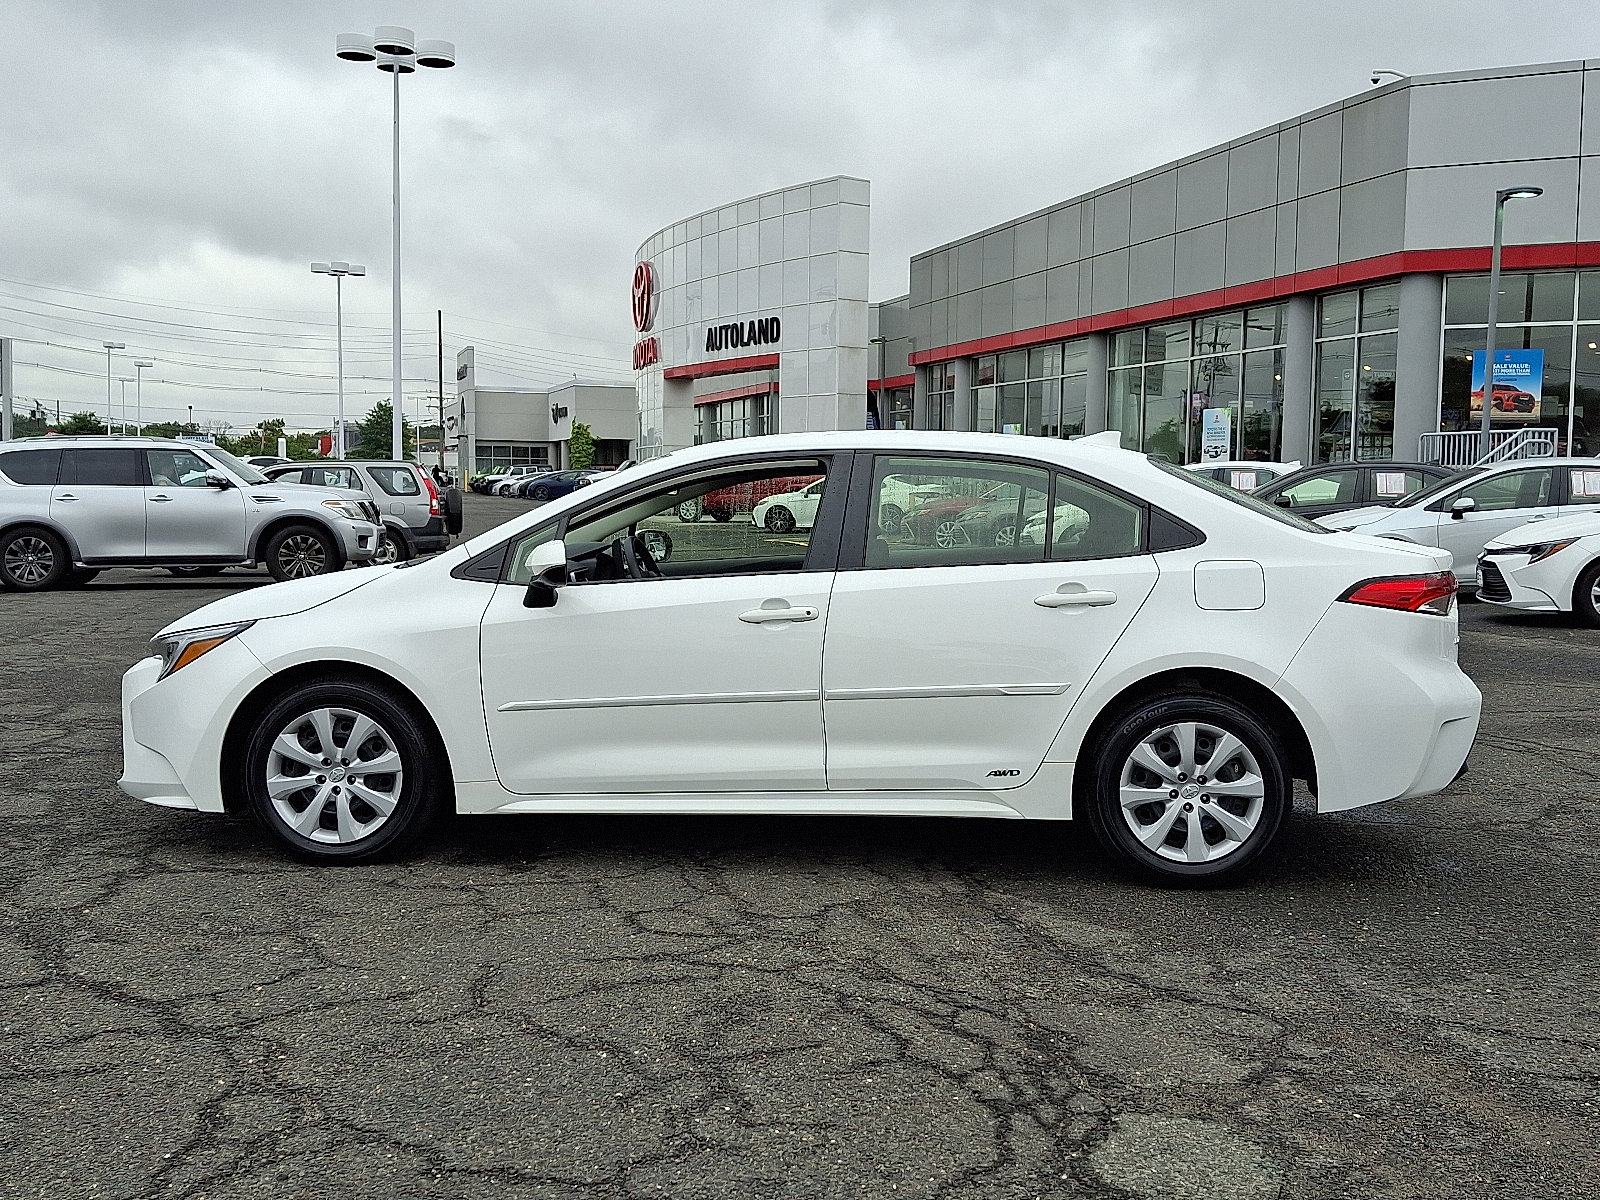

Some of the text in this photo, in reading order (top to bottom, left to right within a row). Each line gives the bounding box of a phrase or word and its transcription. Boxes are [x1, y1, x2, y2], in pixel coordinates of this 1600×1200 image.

[705, 316, 781, 352] AUTOLAND
[633, 337, 657, 370] OYOTA
[985, 769, 1021, 777] AWD
